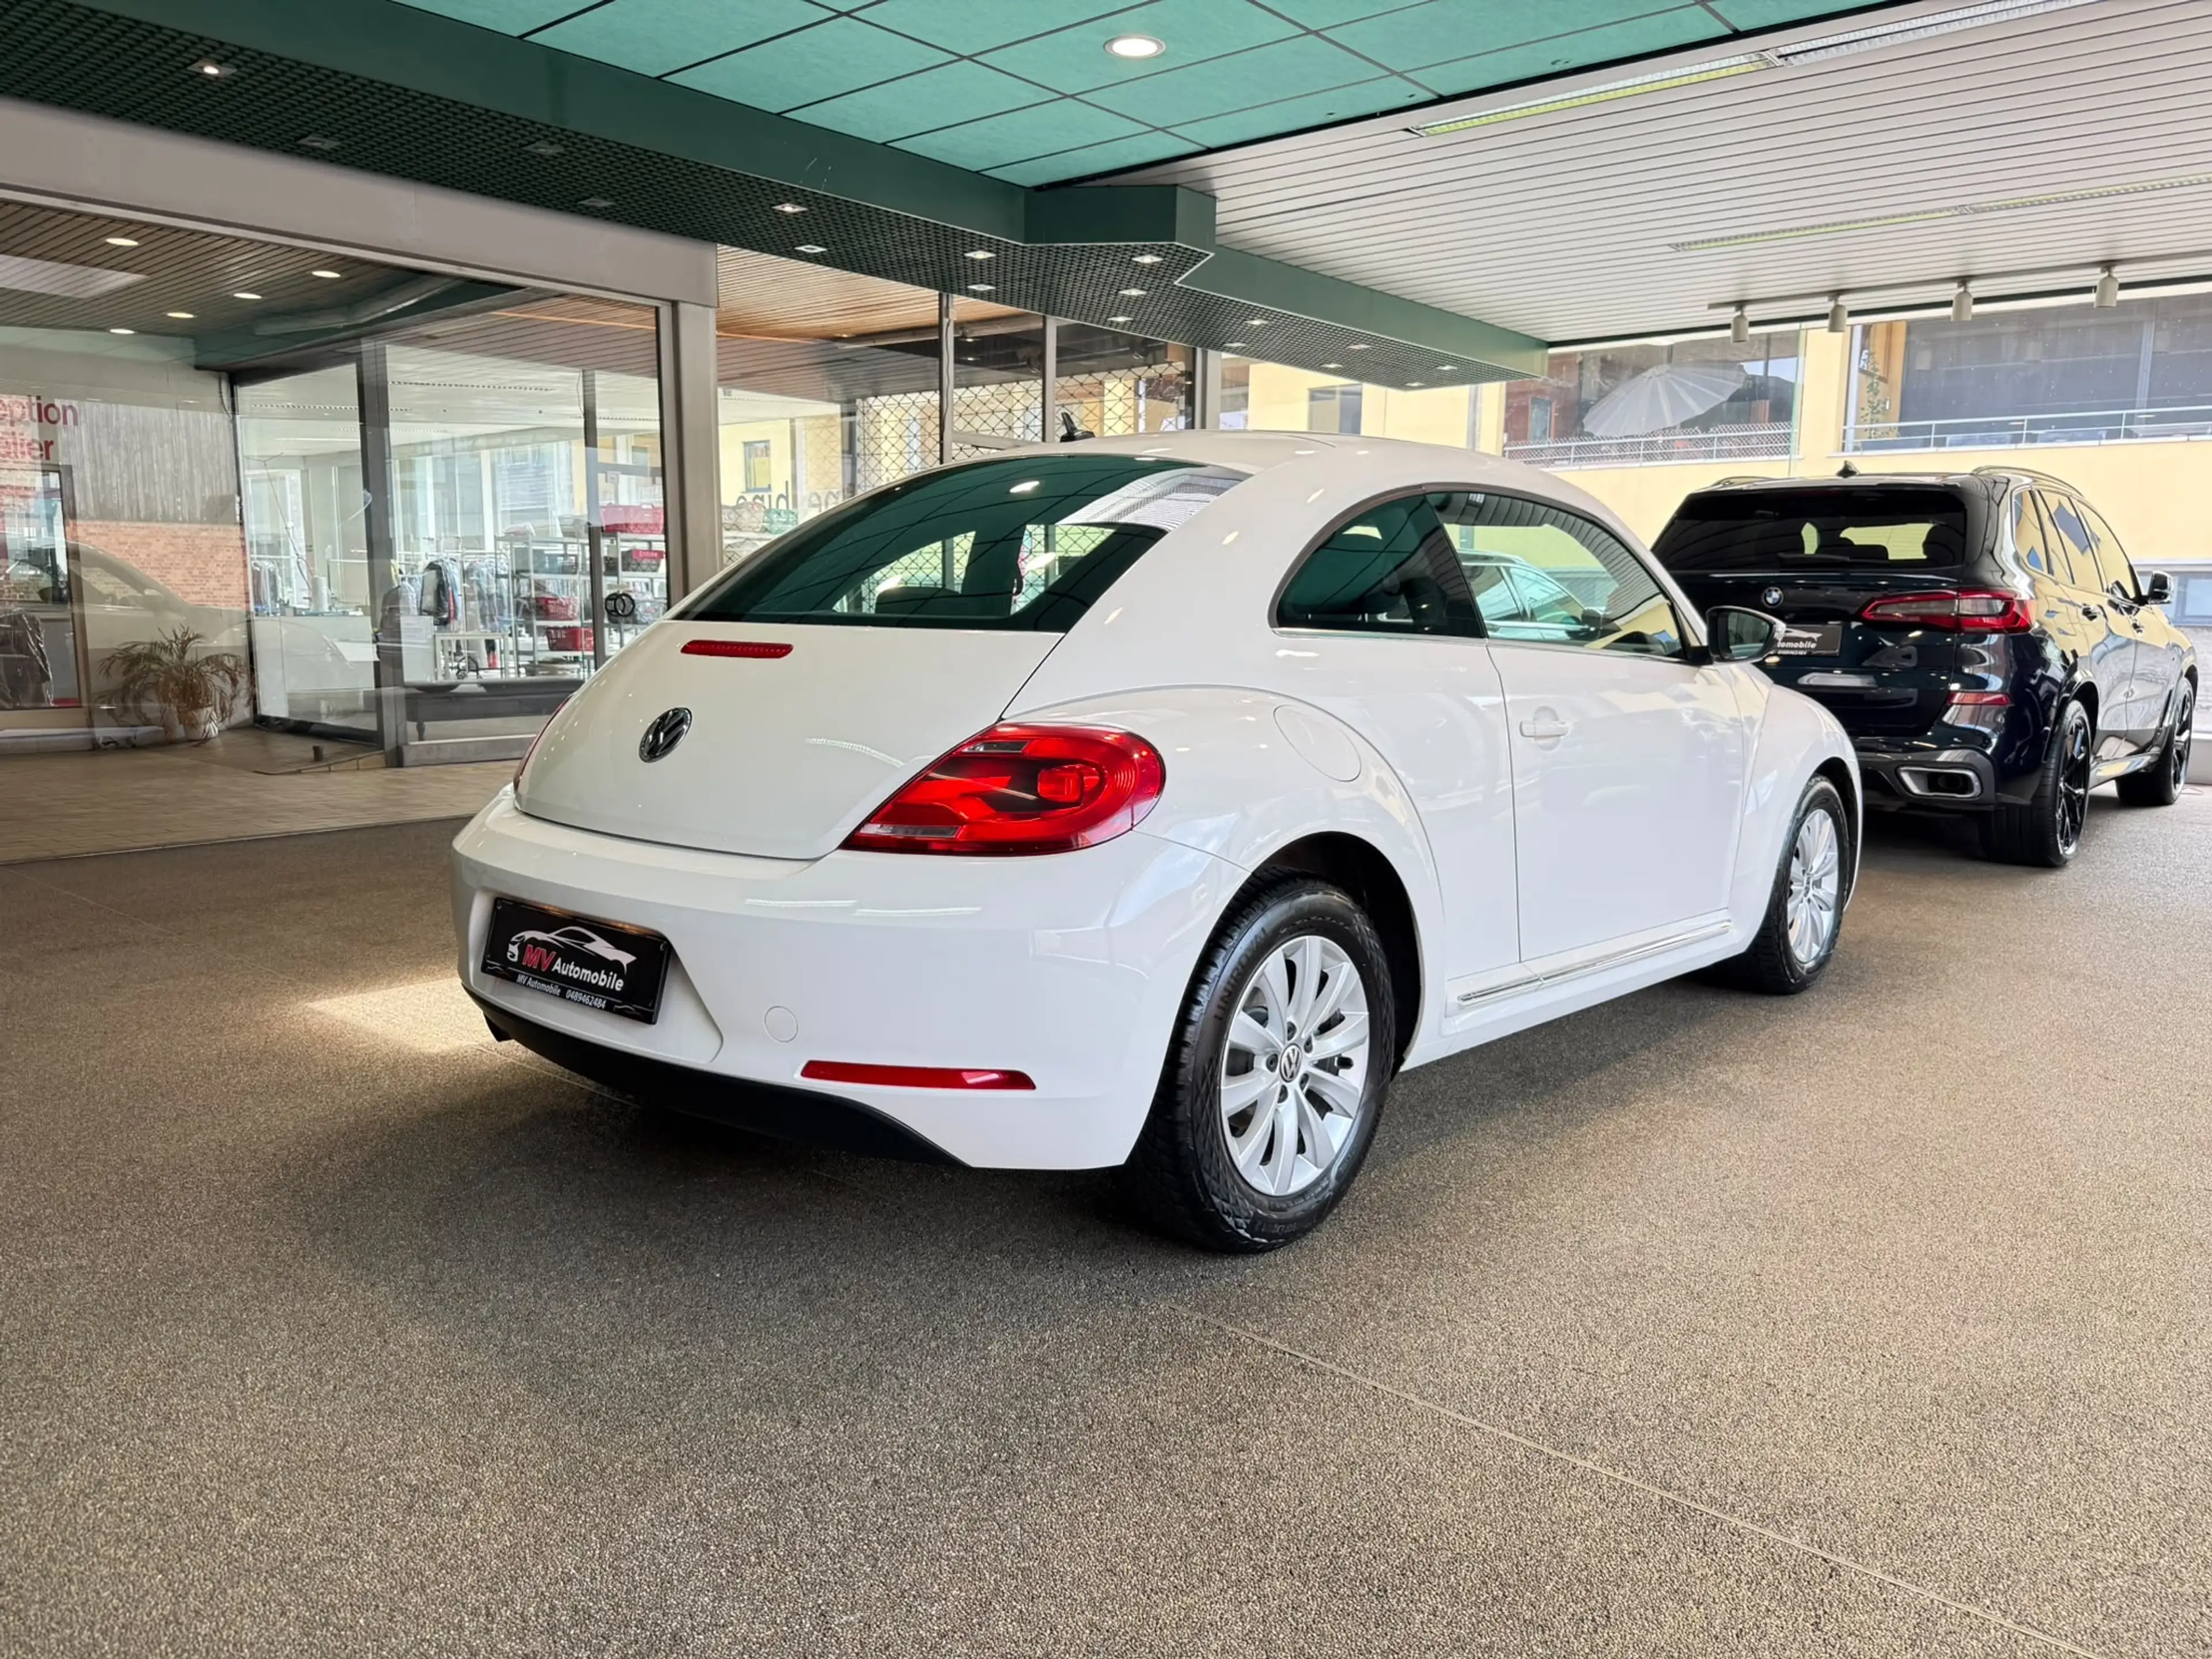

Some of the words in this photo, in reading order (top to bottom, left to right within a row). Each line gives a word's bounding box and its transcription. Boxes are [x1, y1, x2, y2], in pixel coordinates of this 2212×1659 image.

[522, 944, 556, 972] MV
[551, 957, 624, 991] Automobile
[516, 974, 528, 984] MV
[527, 977, 561, 997] Automobile
[566, 989, 606, 1009] 0489462484
